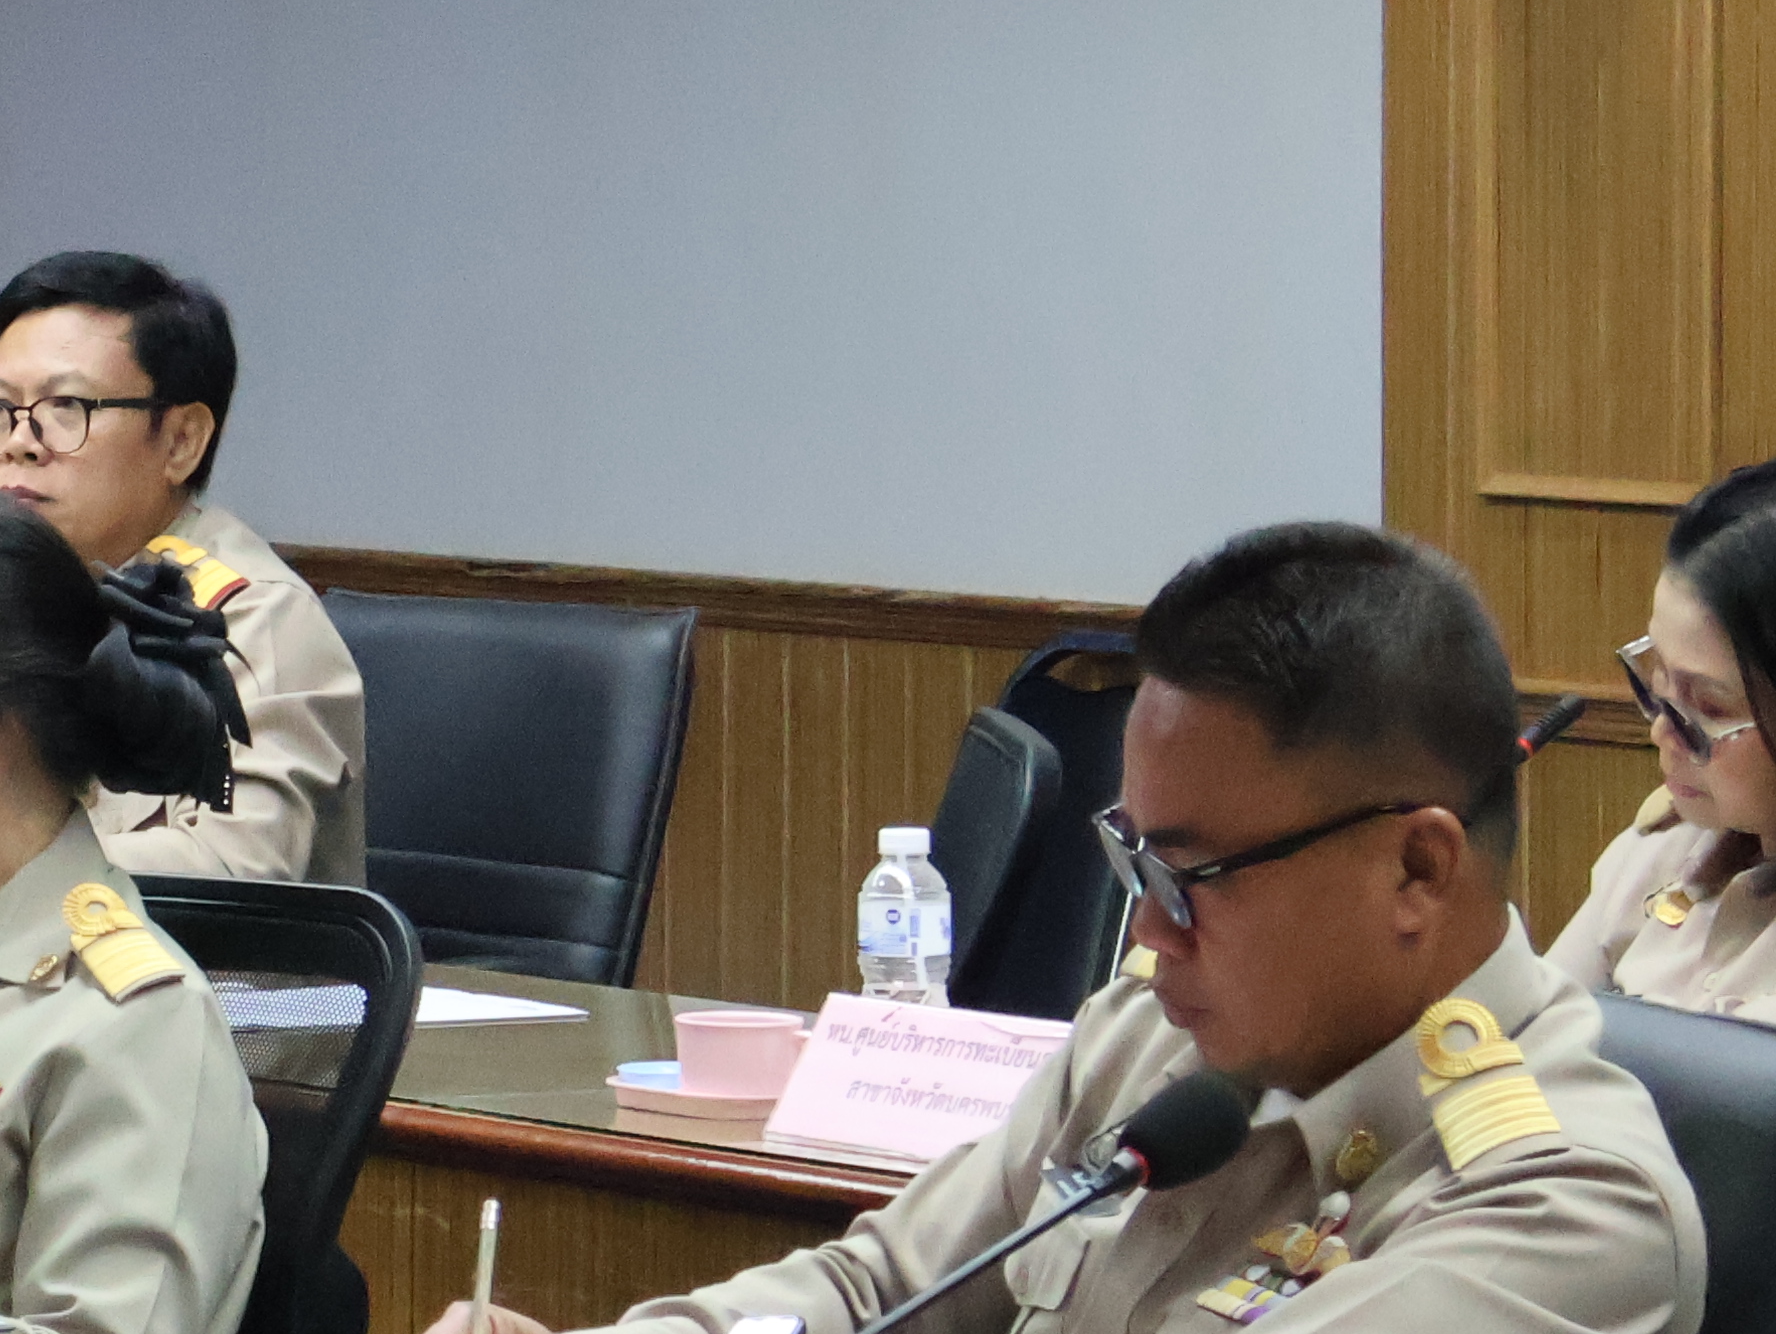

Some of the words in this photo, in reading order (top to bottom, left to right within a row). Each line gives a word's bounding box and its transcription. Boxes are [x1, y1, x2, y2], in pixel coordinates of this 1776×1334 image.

[846, 1077, 1010, 1120] สาขาจังหวัดนครพน
